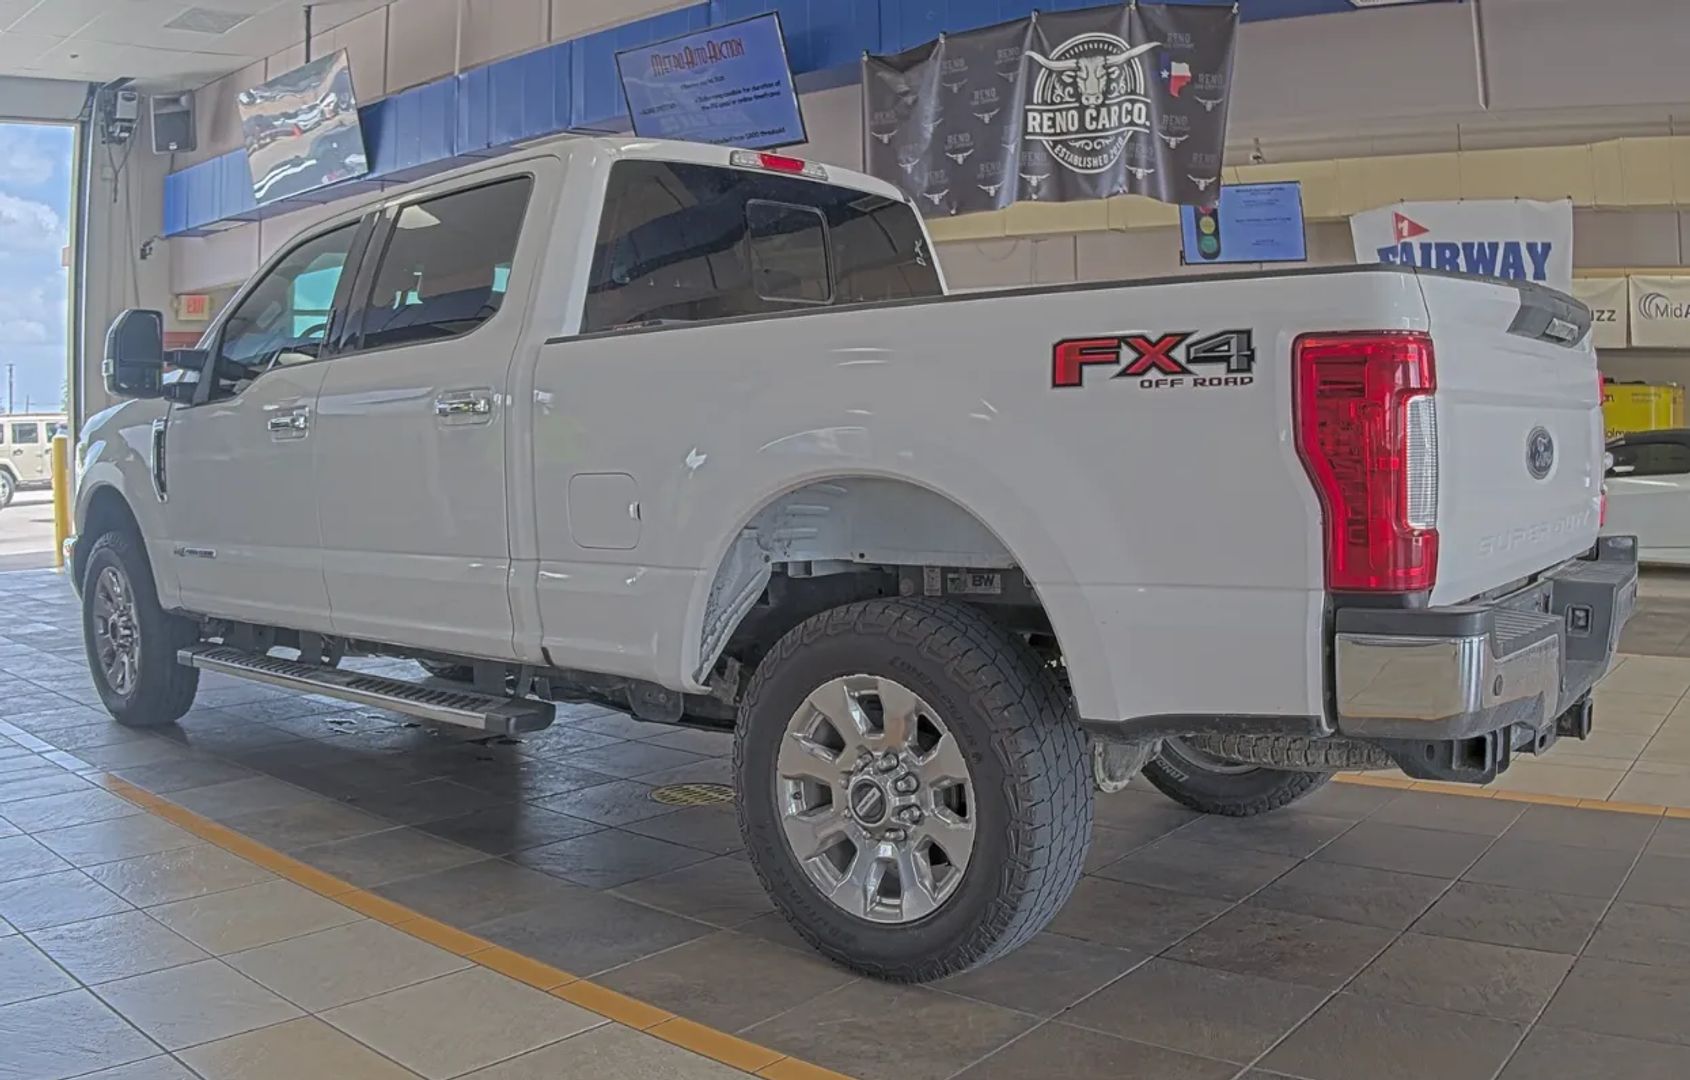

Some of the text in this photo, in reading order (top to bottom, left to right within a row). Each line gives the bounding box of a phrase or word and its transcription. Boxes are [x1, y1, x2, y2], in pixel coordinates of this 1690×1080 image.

[1027, 102, 1151, 133] RENO CAR CO.
[1053, 144, 1109, 169] ESTABLISHED
[1398, 220, 1409, 237] 1
[1377, 241, 1552, 281] FAIRWAY
[1052, 328, 1256, 389] FX4
[1140, 376, 1254, 389] OFF ROAD
